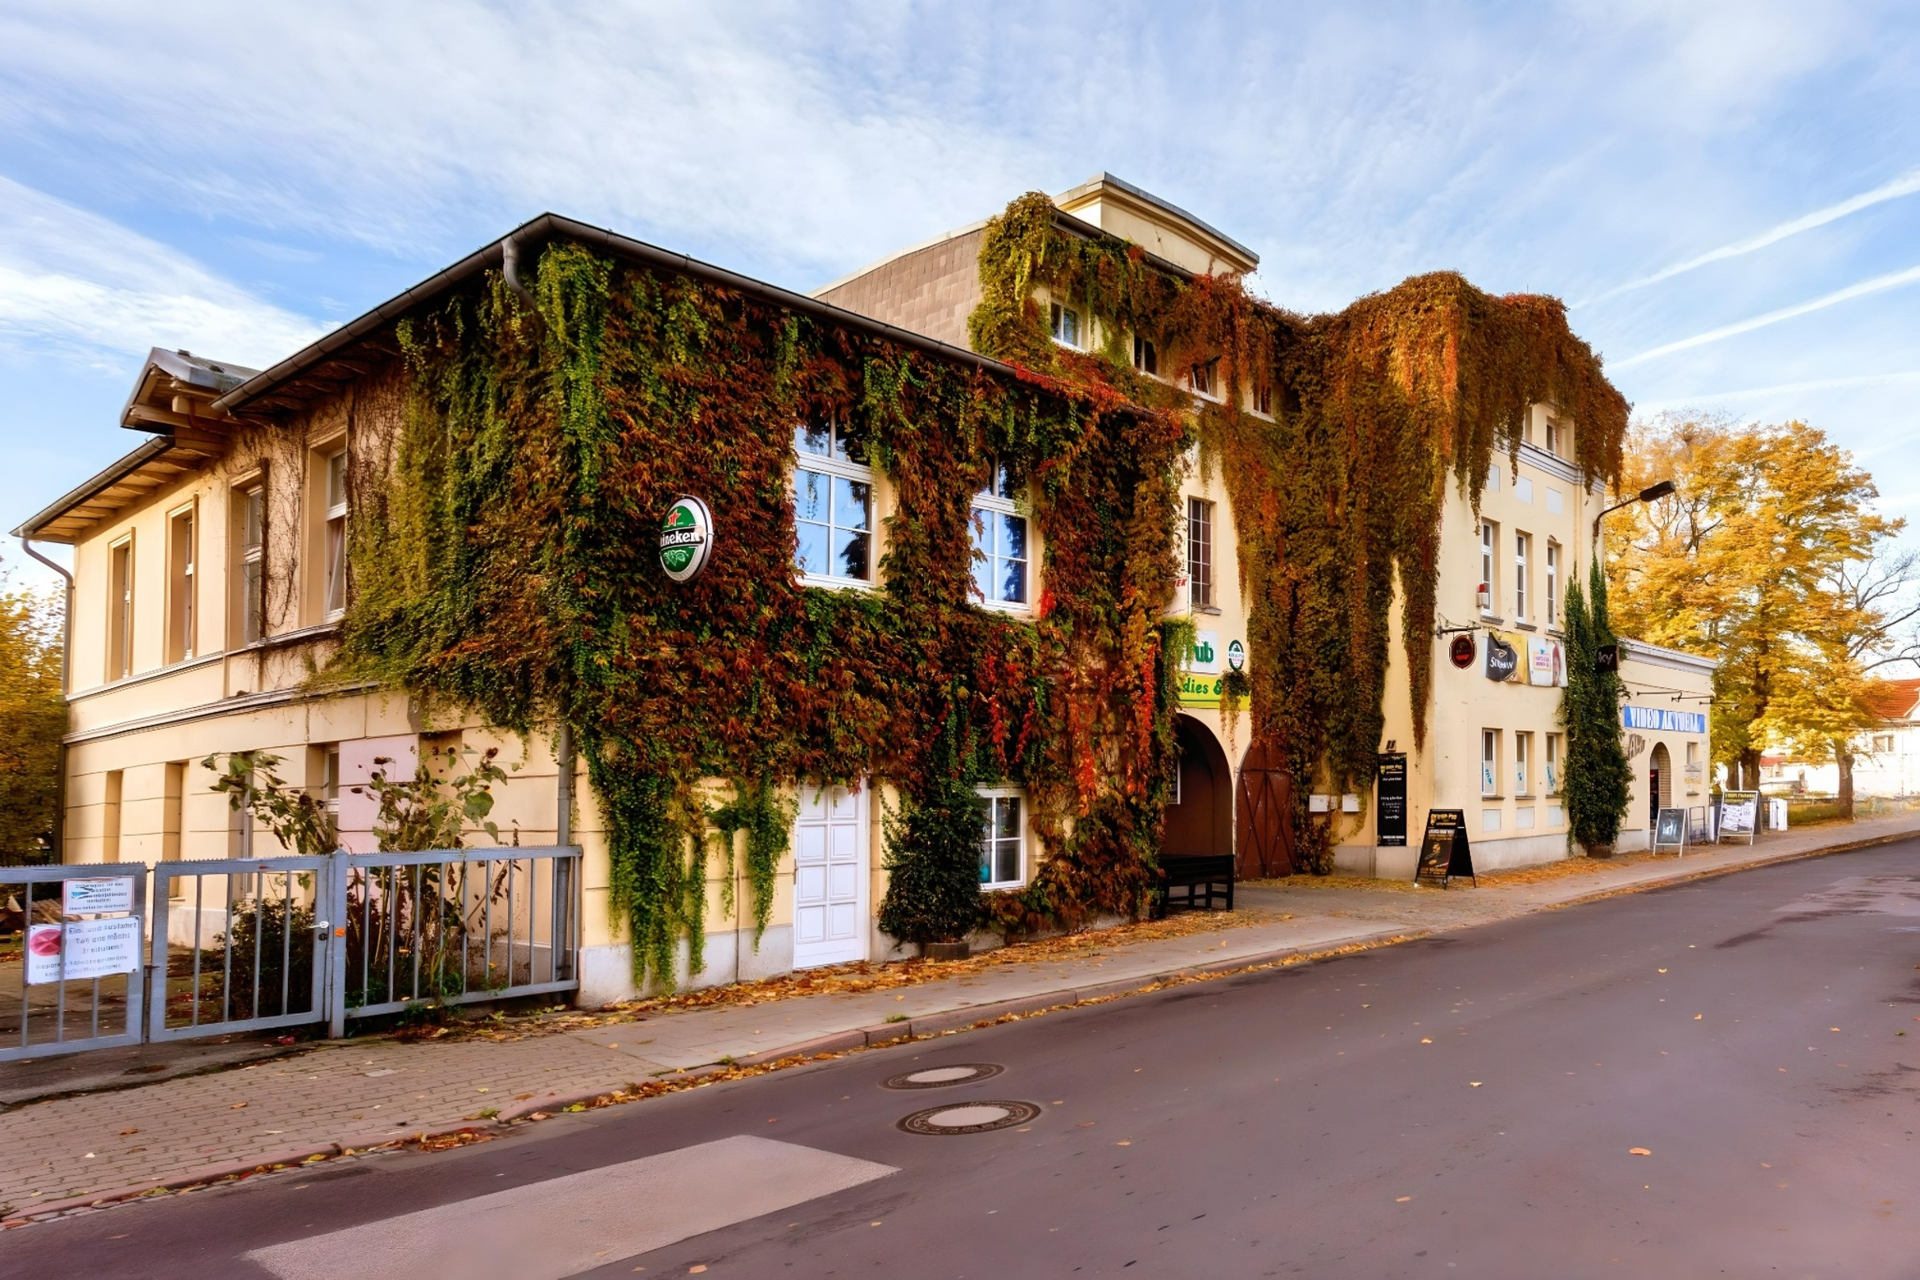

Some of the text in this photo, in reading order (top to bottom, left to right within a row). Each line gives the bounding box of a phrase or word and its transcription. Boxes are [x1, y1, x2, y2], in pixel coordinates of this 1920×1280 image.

[1193, 641, 1214, 663] ub
[1181, 677, 1209, 694] dies
[1629, 706, 1660, 730] VIDEO
